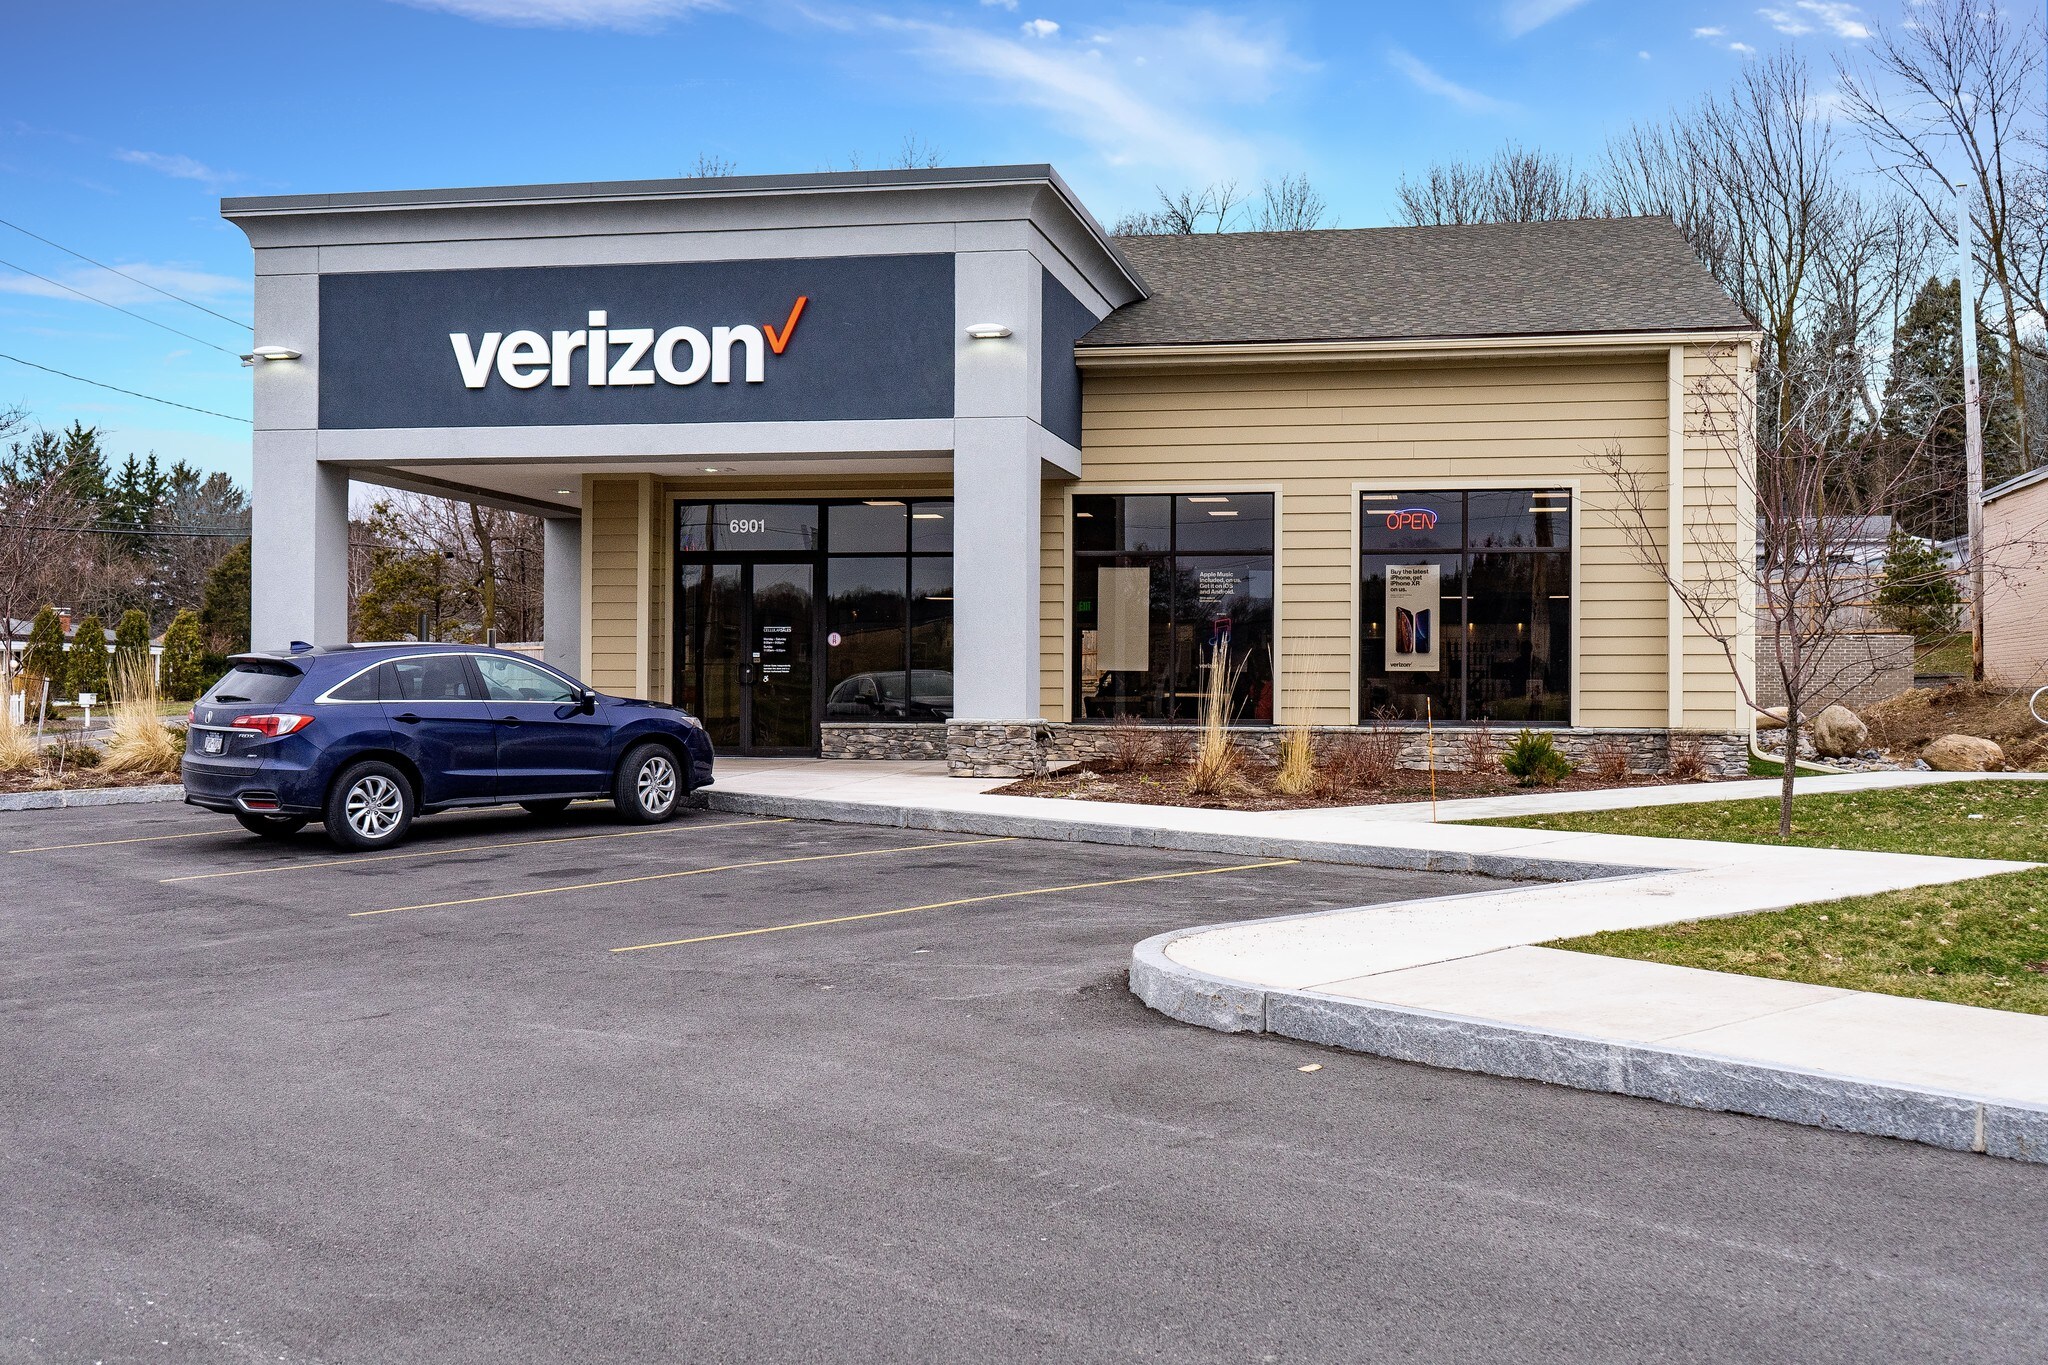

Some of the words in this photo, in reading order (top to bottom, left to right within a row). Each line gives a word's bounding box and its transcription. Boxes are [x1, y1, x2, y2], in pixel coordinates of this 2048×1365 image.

[449, 310, 765, 389] verizon
[730, 519, 765, 533] 6901
[1386, 512, 1435, 530] OPEN
